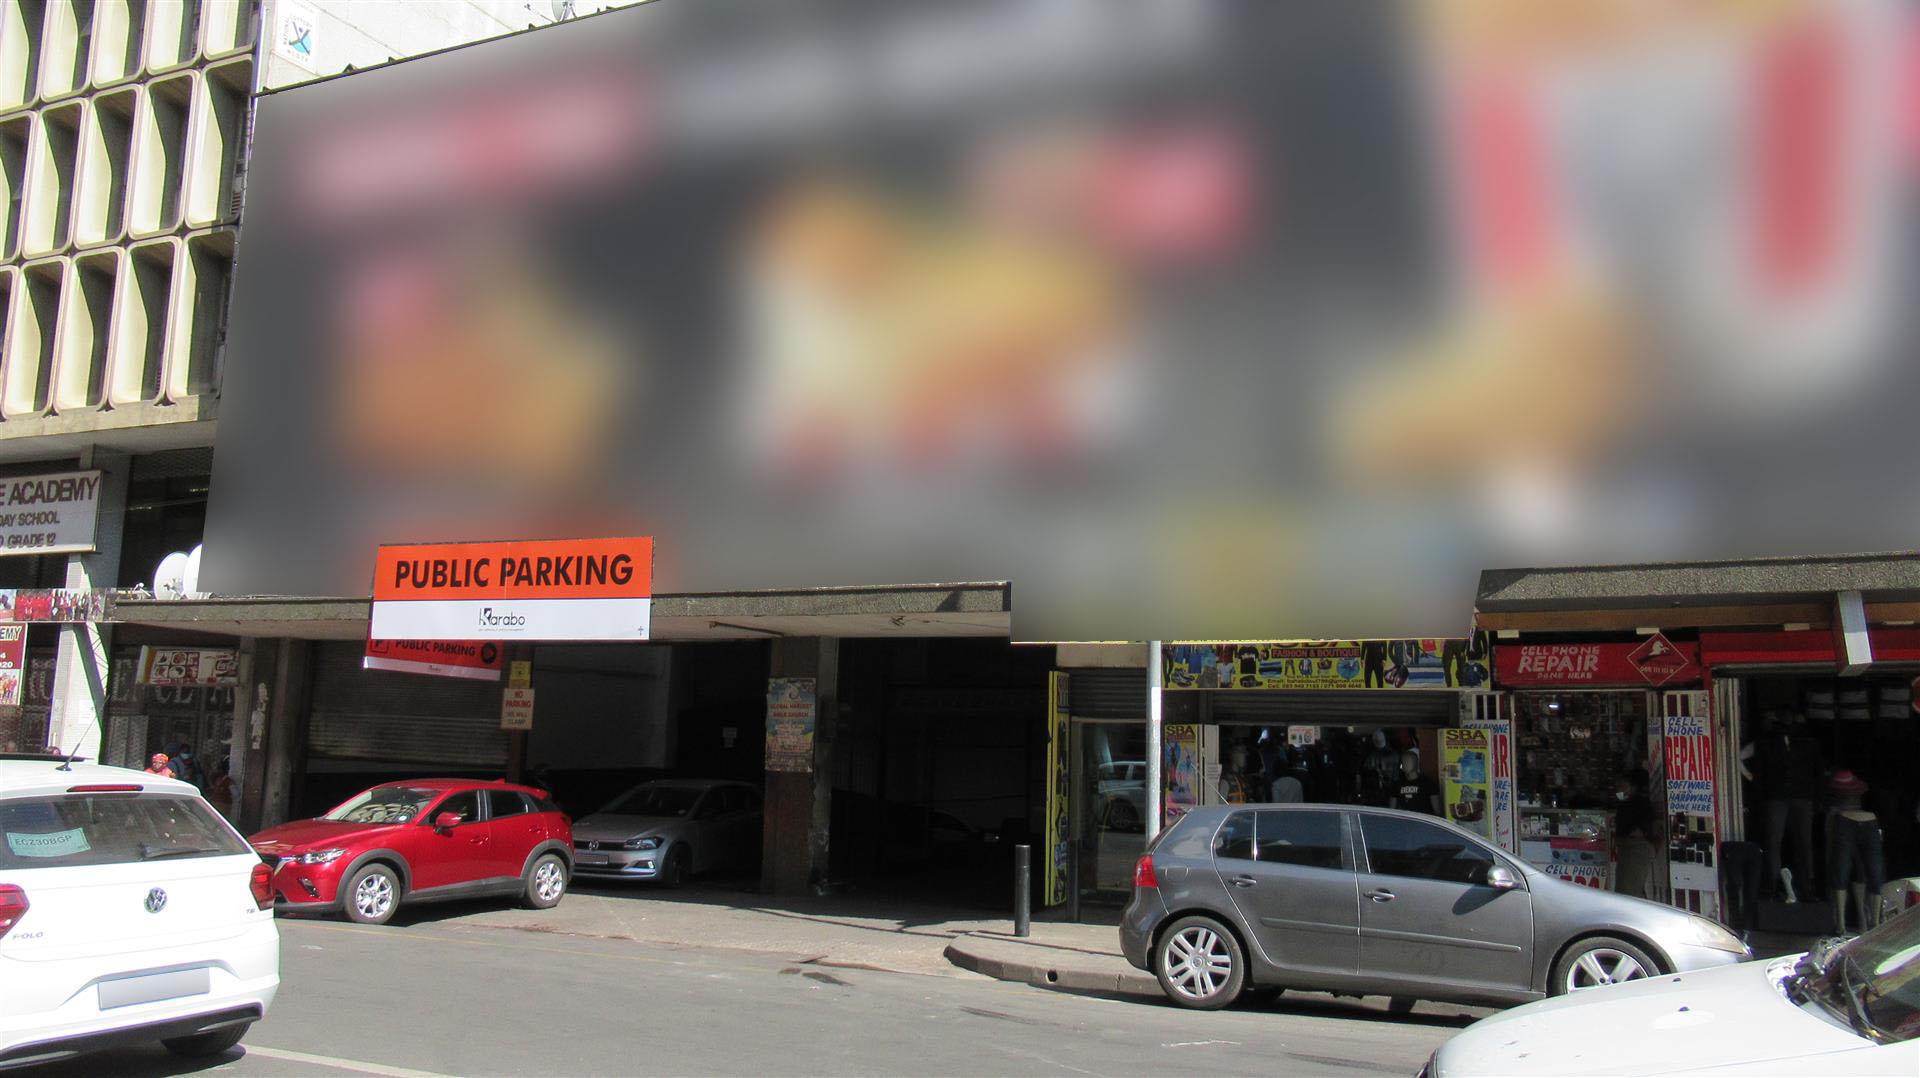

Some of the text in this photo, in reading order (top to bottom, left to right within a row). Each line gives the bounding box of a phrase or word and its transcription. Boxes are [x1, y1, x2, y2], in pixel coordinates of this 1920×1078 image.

[8, 476, 99, 506] ACADEMY
[18, 511, 60, 526] SCHOOL
[8, 533, 45, 548] GRADE
[46, 533, 56, 546] 12
[395, 553, 634, 589] PUBLIC PARKING
[479, 608, 525, 626] Karabo
[395, 640, 476, 657] PUBLIC PARKING
[1521, 646, 1600, 655] CELL PHONE
[1518, 655, 1599, 673] REPAIR
[505, 700, 532, 708] PARKING
[1166, 725, 1195, 736] SBA
[1446, 730, 1485, 740] SBA
[1667, 727, 1704, 736] PHONE
[1665, 735, 1713, 781] REPAIR
[1667, 781, 1711, 790] SOFTWARE
[1668, 793, 1713, 803] HARDWARE
[1670, 803, 1711, 812] DONE HERE
[1545, 865, 1607, 877] CELL PHONE
